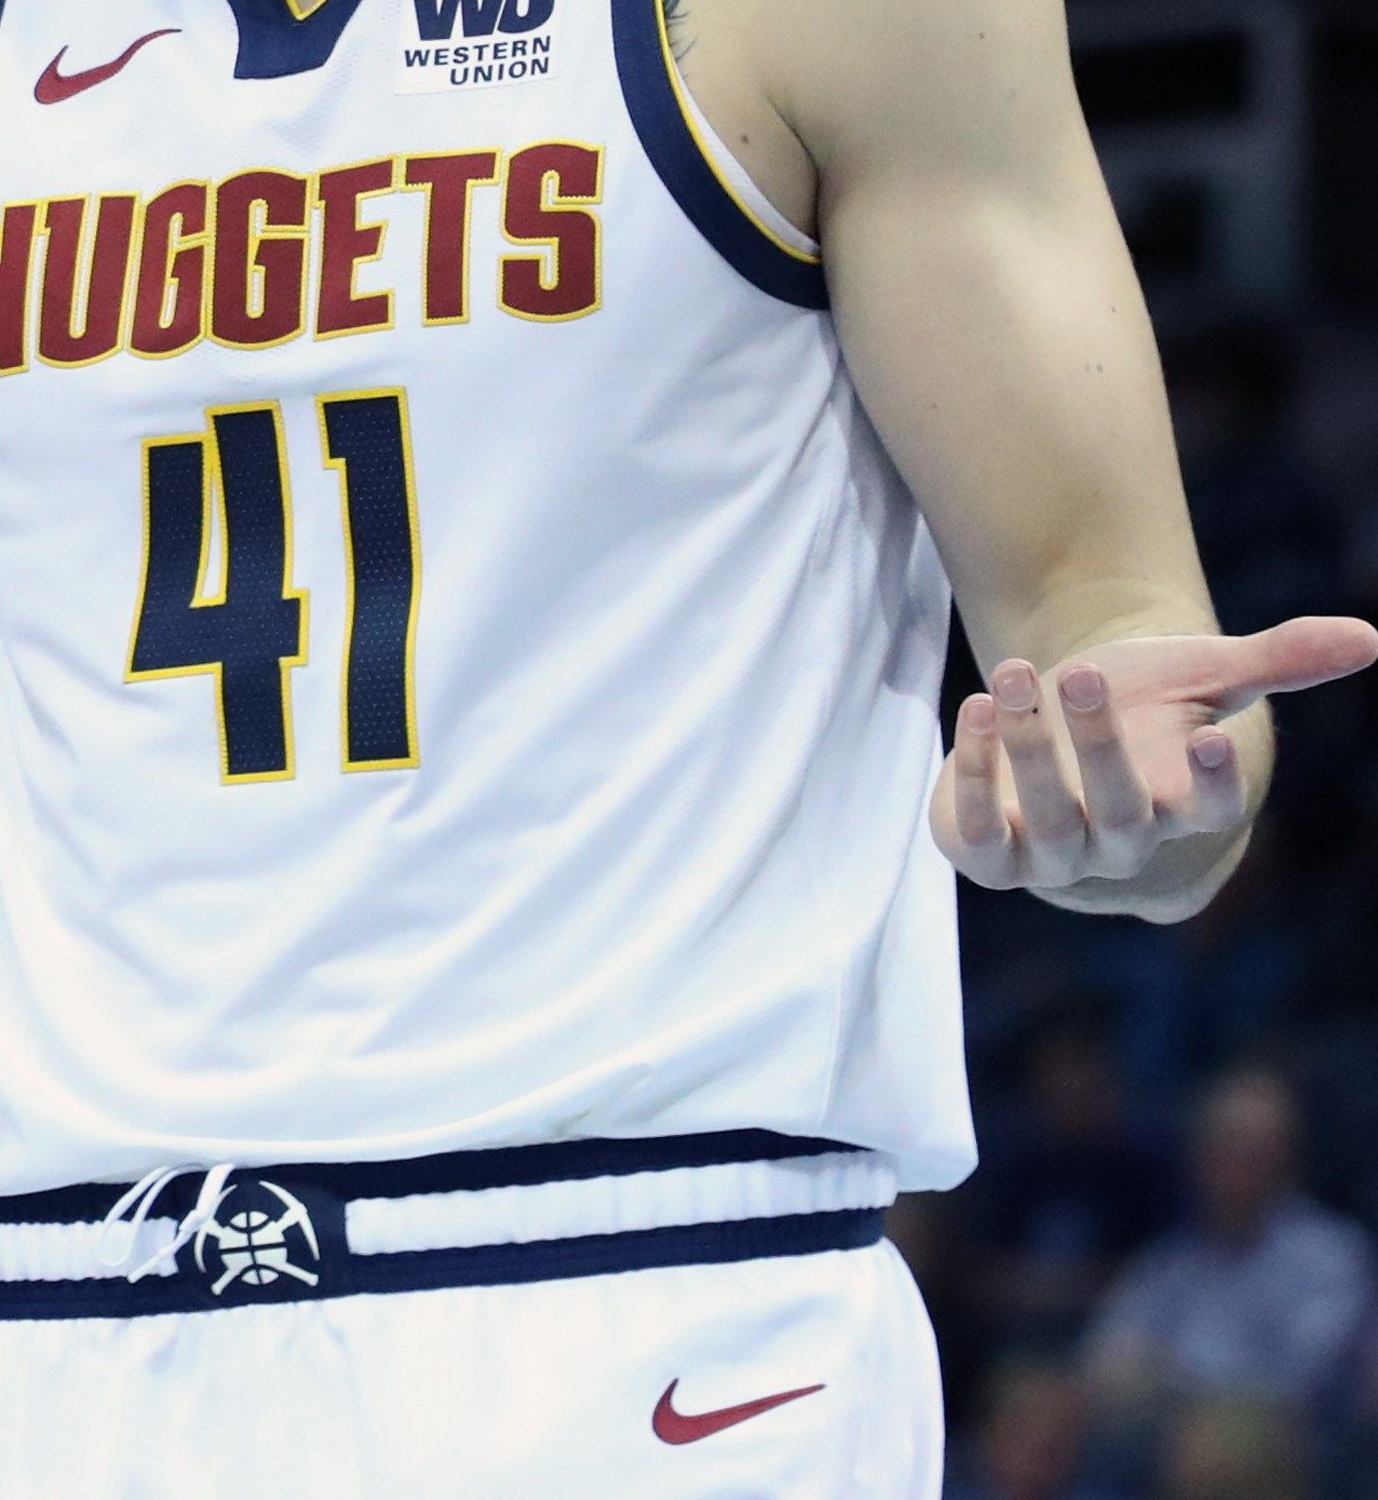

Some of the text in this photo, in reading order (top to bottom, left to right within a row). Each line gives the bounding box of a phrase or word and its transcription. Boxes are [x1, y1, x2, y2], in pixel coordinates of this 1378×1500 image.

[404, 34, 552, 68] WESTERN
[449, 56, 550, 86] UNION
[123, 385, 423, 787] 41
